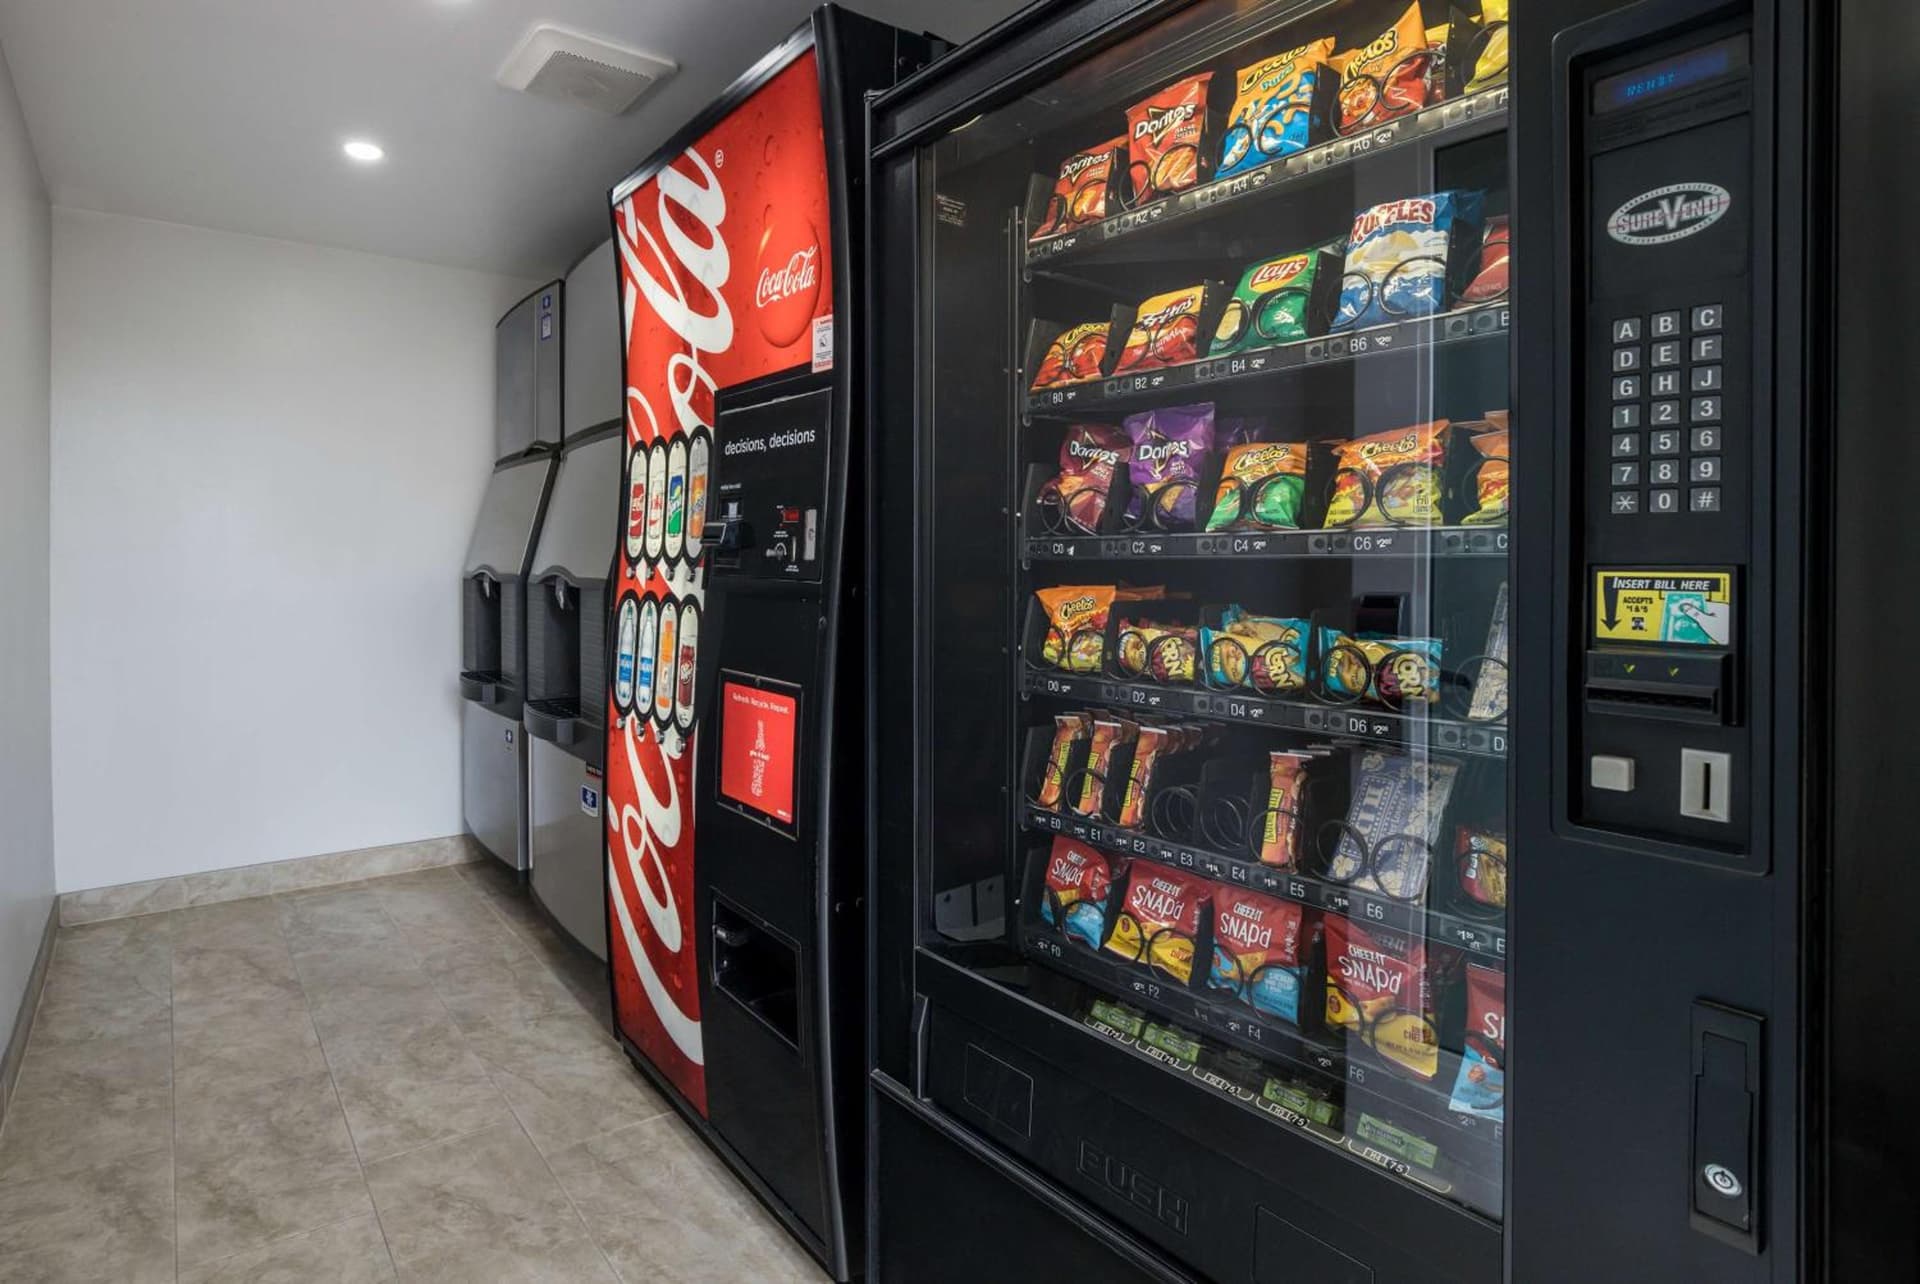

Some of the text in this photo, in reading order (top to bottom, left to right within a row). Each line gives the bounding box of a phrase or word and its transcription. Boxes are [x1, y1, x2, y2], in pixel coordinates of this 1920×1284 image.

[1135, 104, 1195, 139] Doritos
[1352, 139, 1370, 153] A6
[1059, 152, 1110, 179] Doritos
[1232, 179, 1247, 193] A4
[1134, 212, 1148, 225] A2
[1350, 198, 1435, 242] RUFFLES
[1619, 309, 1714, 339] A B C
[1350, 337, 1367, 352] B6
[1620, 339, 1713, 367] D E F
[1231, 360, 1245, 373] B4
[1134, 377, 1147, 390] B2
[1620, 369, 1713, 395] G H J
[1621, 400, 1713, 424] 1 2 3
[725, 428, 816, 456] decisions, decisions
[1360, 431, 1418, 458] Cheetos
[1619, 430, 1713, 453] 4 5 6
[1070, 440, 1119, 465] Doritos
[1139, 440, 1189, 460] Doritos
[1620, 461, 1713, 482] 7 8 9
[1658, 493, 1671, 509] 0
[1132, 542, 1145, 553] C2
[1234, 539, 1248, 552] C4
[1354, 536, 1371, 551] C6
[1612, 577, 1711, 591] INSERT BILL HERE
[1060, 597, 1096, 619] Cheetos
[1623, 596, 1653, 605] ACCEPTS
[1132, 691, 1145, 704] D2
[1230, 704, 1245, 717] D4
[1349, 718, 1367, 733] D6
[1091, 829, 1101, 841] E1
[1134, 841, 1146, 853] E2
[1180, 853, 1193, 866] E3
[1232, 867, 1246, 880] E4
[1289, 881, 1305, 898] E5
[1366, 903, 1384, 920] E6
[1220, 912, 1272, 949] SNAP'd
[1338, 955, 1403, 994] SNAP'd
[1148, 985, 1160, 999] F2
[1248, 1025, 1261, 1040] F4
[1350, 1066, 1365, 1083] F6
